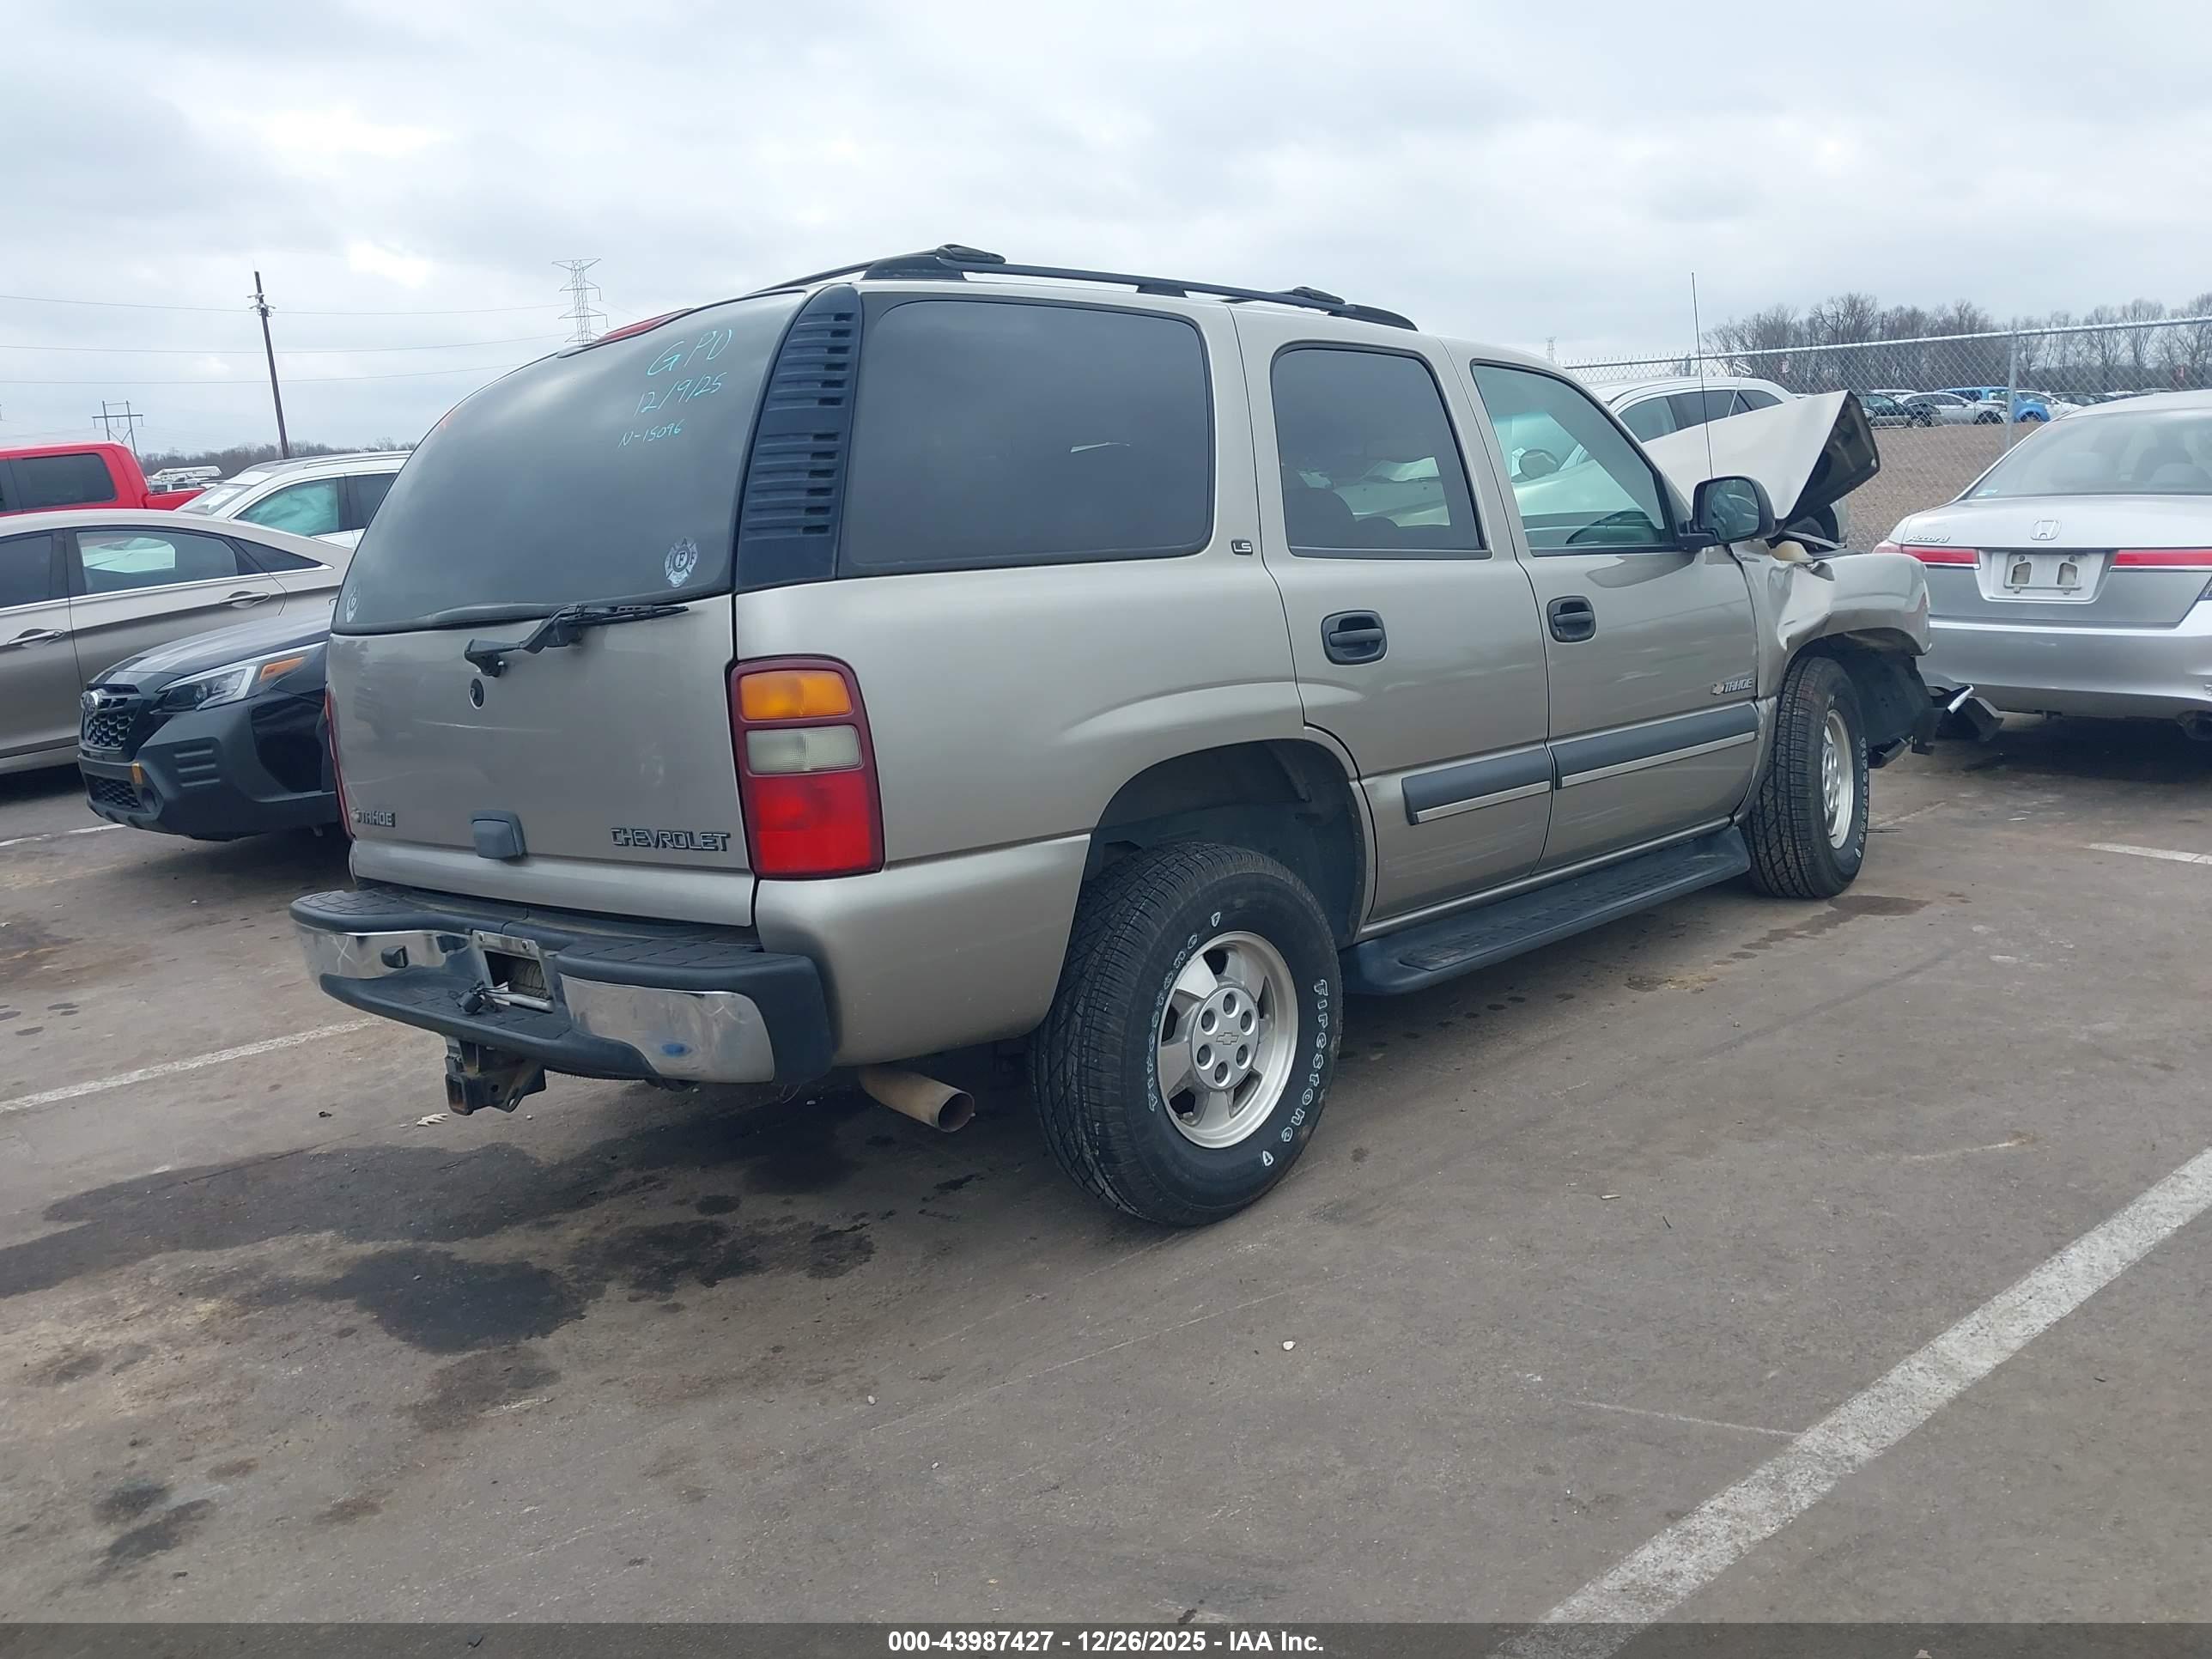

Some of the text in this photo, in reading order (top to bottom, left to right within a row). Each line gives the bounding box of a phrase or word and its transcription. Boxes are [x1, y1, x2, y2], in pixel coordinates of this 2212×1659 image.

[634, 372, 728, 417] 12/9/25
[1232, 542, 1251, 552] LS
[1905, 535, 1950, 544] Accord
[1723, 678, 1753, 693] TAHOE
[356, 810, 395, 827] TAHOE
[611, 827, 731, 852] CHEVROLET
[1281, 979, 1328, 1142] Firestone
